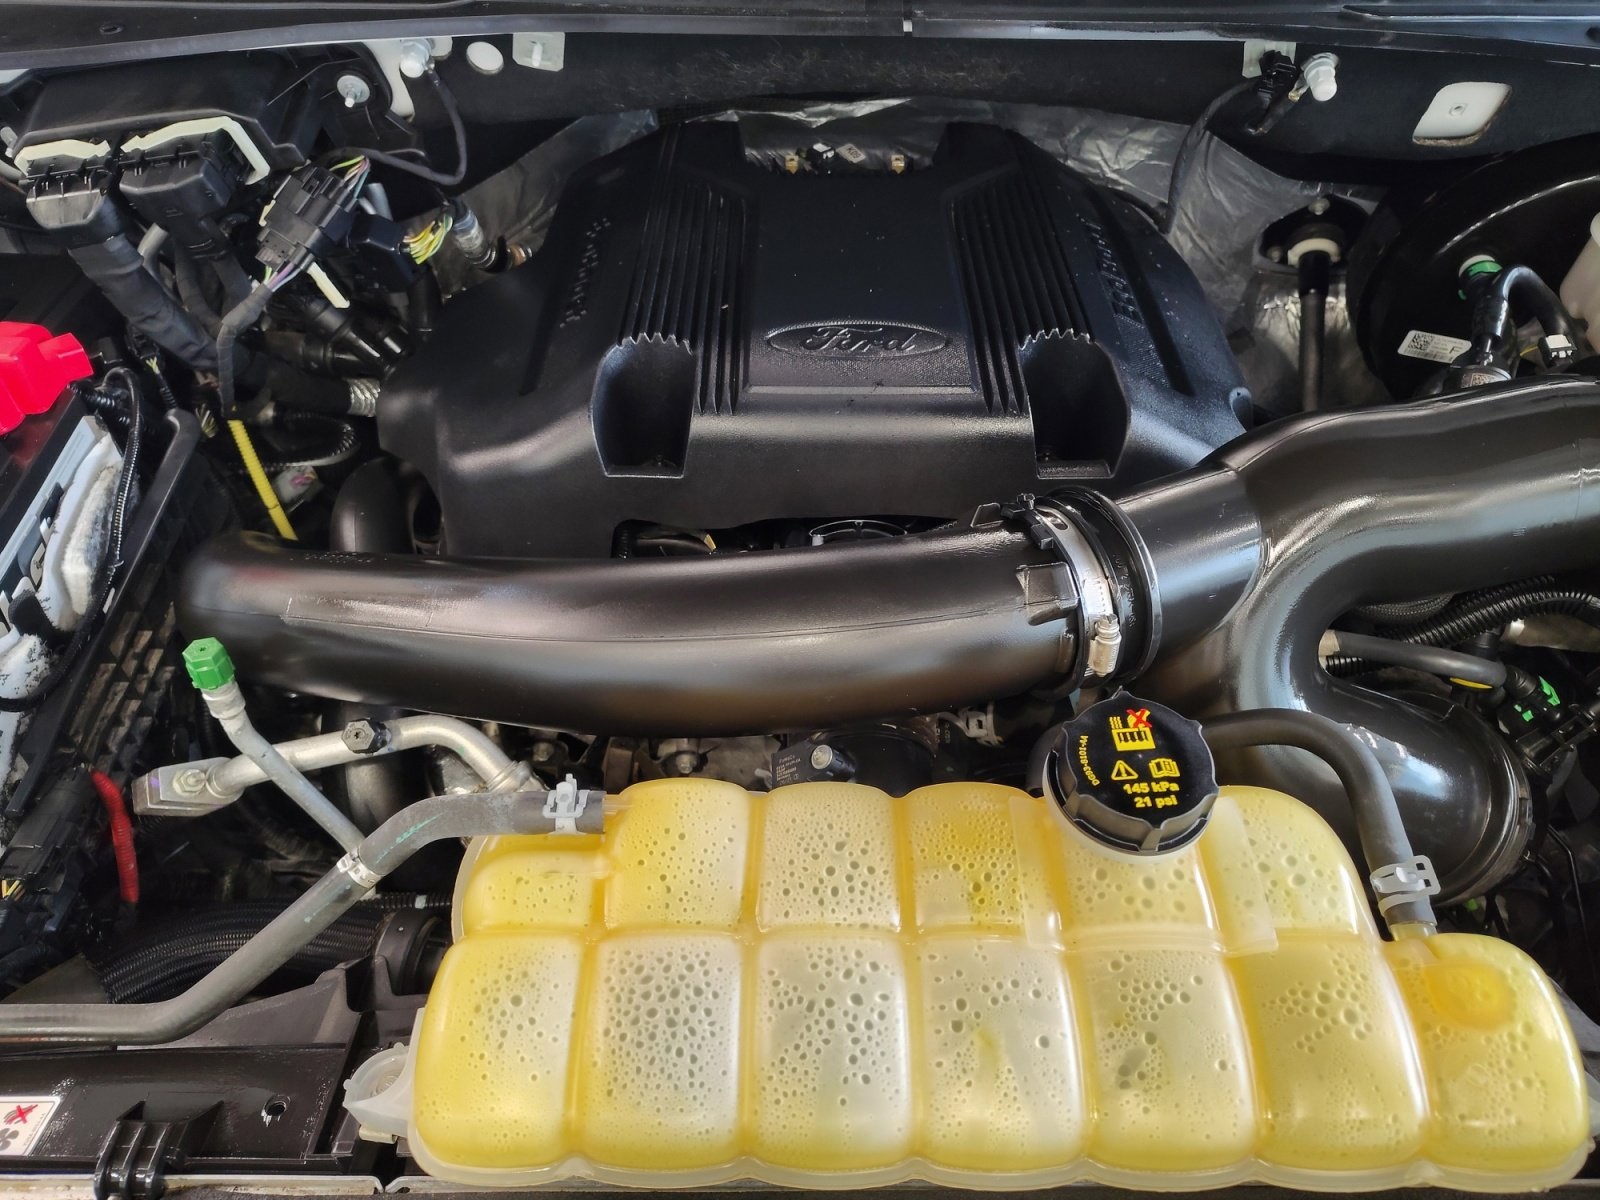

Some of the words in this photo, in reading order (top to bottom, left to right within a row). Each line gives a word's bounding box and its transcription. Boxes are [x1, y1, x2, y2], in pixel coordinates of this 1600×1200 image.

[805, 326, 918, 352] Ford
[1123, 782, 1149, 795] 145
[1151, 781, 1180, 793] kPa
[1134, 796, 1152, 808] 21
[1155, 795, 1178, 808] psi
